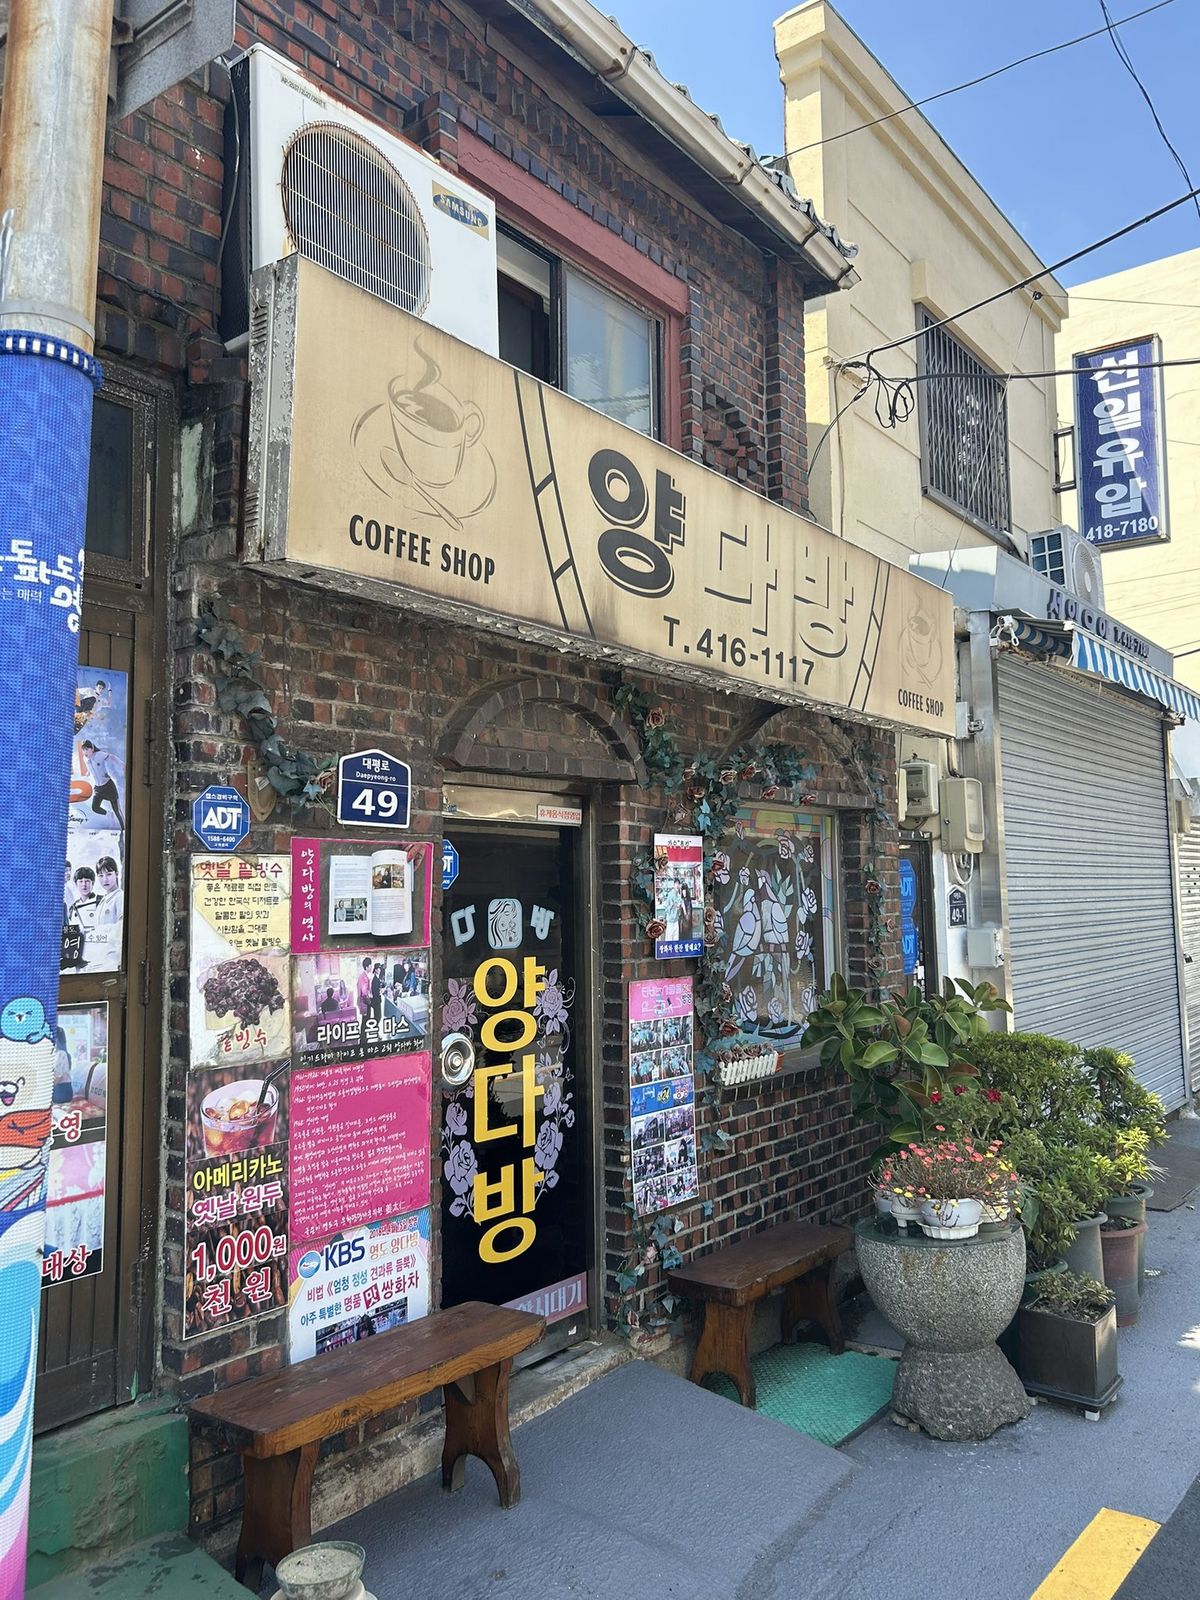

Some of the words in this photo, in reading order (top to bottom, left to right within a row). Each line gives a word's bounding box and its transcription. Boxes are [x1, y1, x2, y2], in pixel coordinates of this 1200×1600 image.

[440, 193, 484, 227] SAMSUNG
[1089, 349, 1147, 519] 선일유압
[1086, 516, 1159, 541] 418-7180
[349, 514, 431, 566] COFFEE
[440, 543, 495, 584] SHOP
[663, 615, 815, 685] T.416-1117
[897, 688, 924, 713] COFFEE
[925, 696, 944, 718] SHOP
[355, 771, 397, 783] Daepyeong-ro
[362, 757, 391, 772] 대평로
[202, 806, 242, 830] ADT
[351, 788, 398, 818] 49
[200, 861, 232, 878] 옛날
[301, 848, 315, 911] 양다방의
[301, 916, 315, 942] 역사
[951, 908, 965, 923] 49-1
[317, 1021, 360, 1044] 라이프
[364, 1018, 379, 1043] 온
[383, 1015, 410, 1036] 마스
[473, 956, 546, 1263] 양다방
[193, 1154, 283, 1192] 아메리카노
[193, 1194, 236, 1226] 옛날
[241, 1181, 283, 1213] 원두
[42, 1245, 91, 1281] 대상
[324, 1236, 366, 1271] KBS
[369, 1241, 387, 1261] 영도
[390, 1232, 418, 1255] 양다방
[307, 1284, 324, 1302] 비법
[352, 1270, 368, 1287] 정성
[370, 1259, 394, 1281] 견과류
[300, 1311, 317, 1327] 아주
[319, 1302, 342, 1321] 특별한
[344, 1292, 361, 1312] 명품
[363, 1283, 381, 1309] 맛
[381, 1270, 420, 1300] 쌍화차
